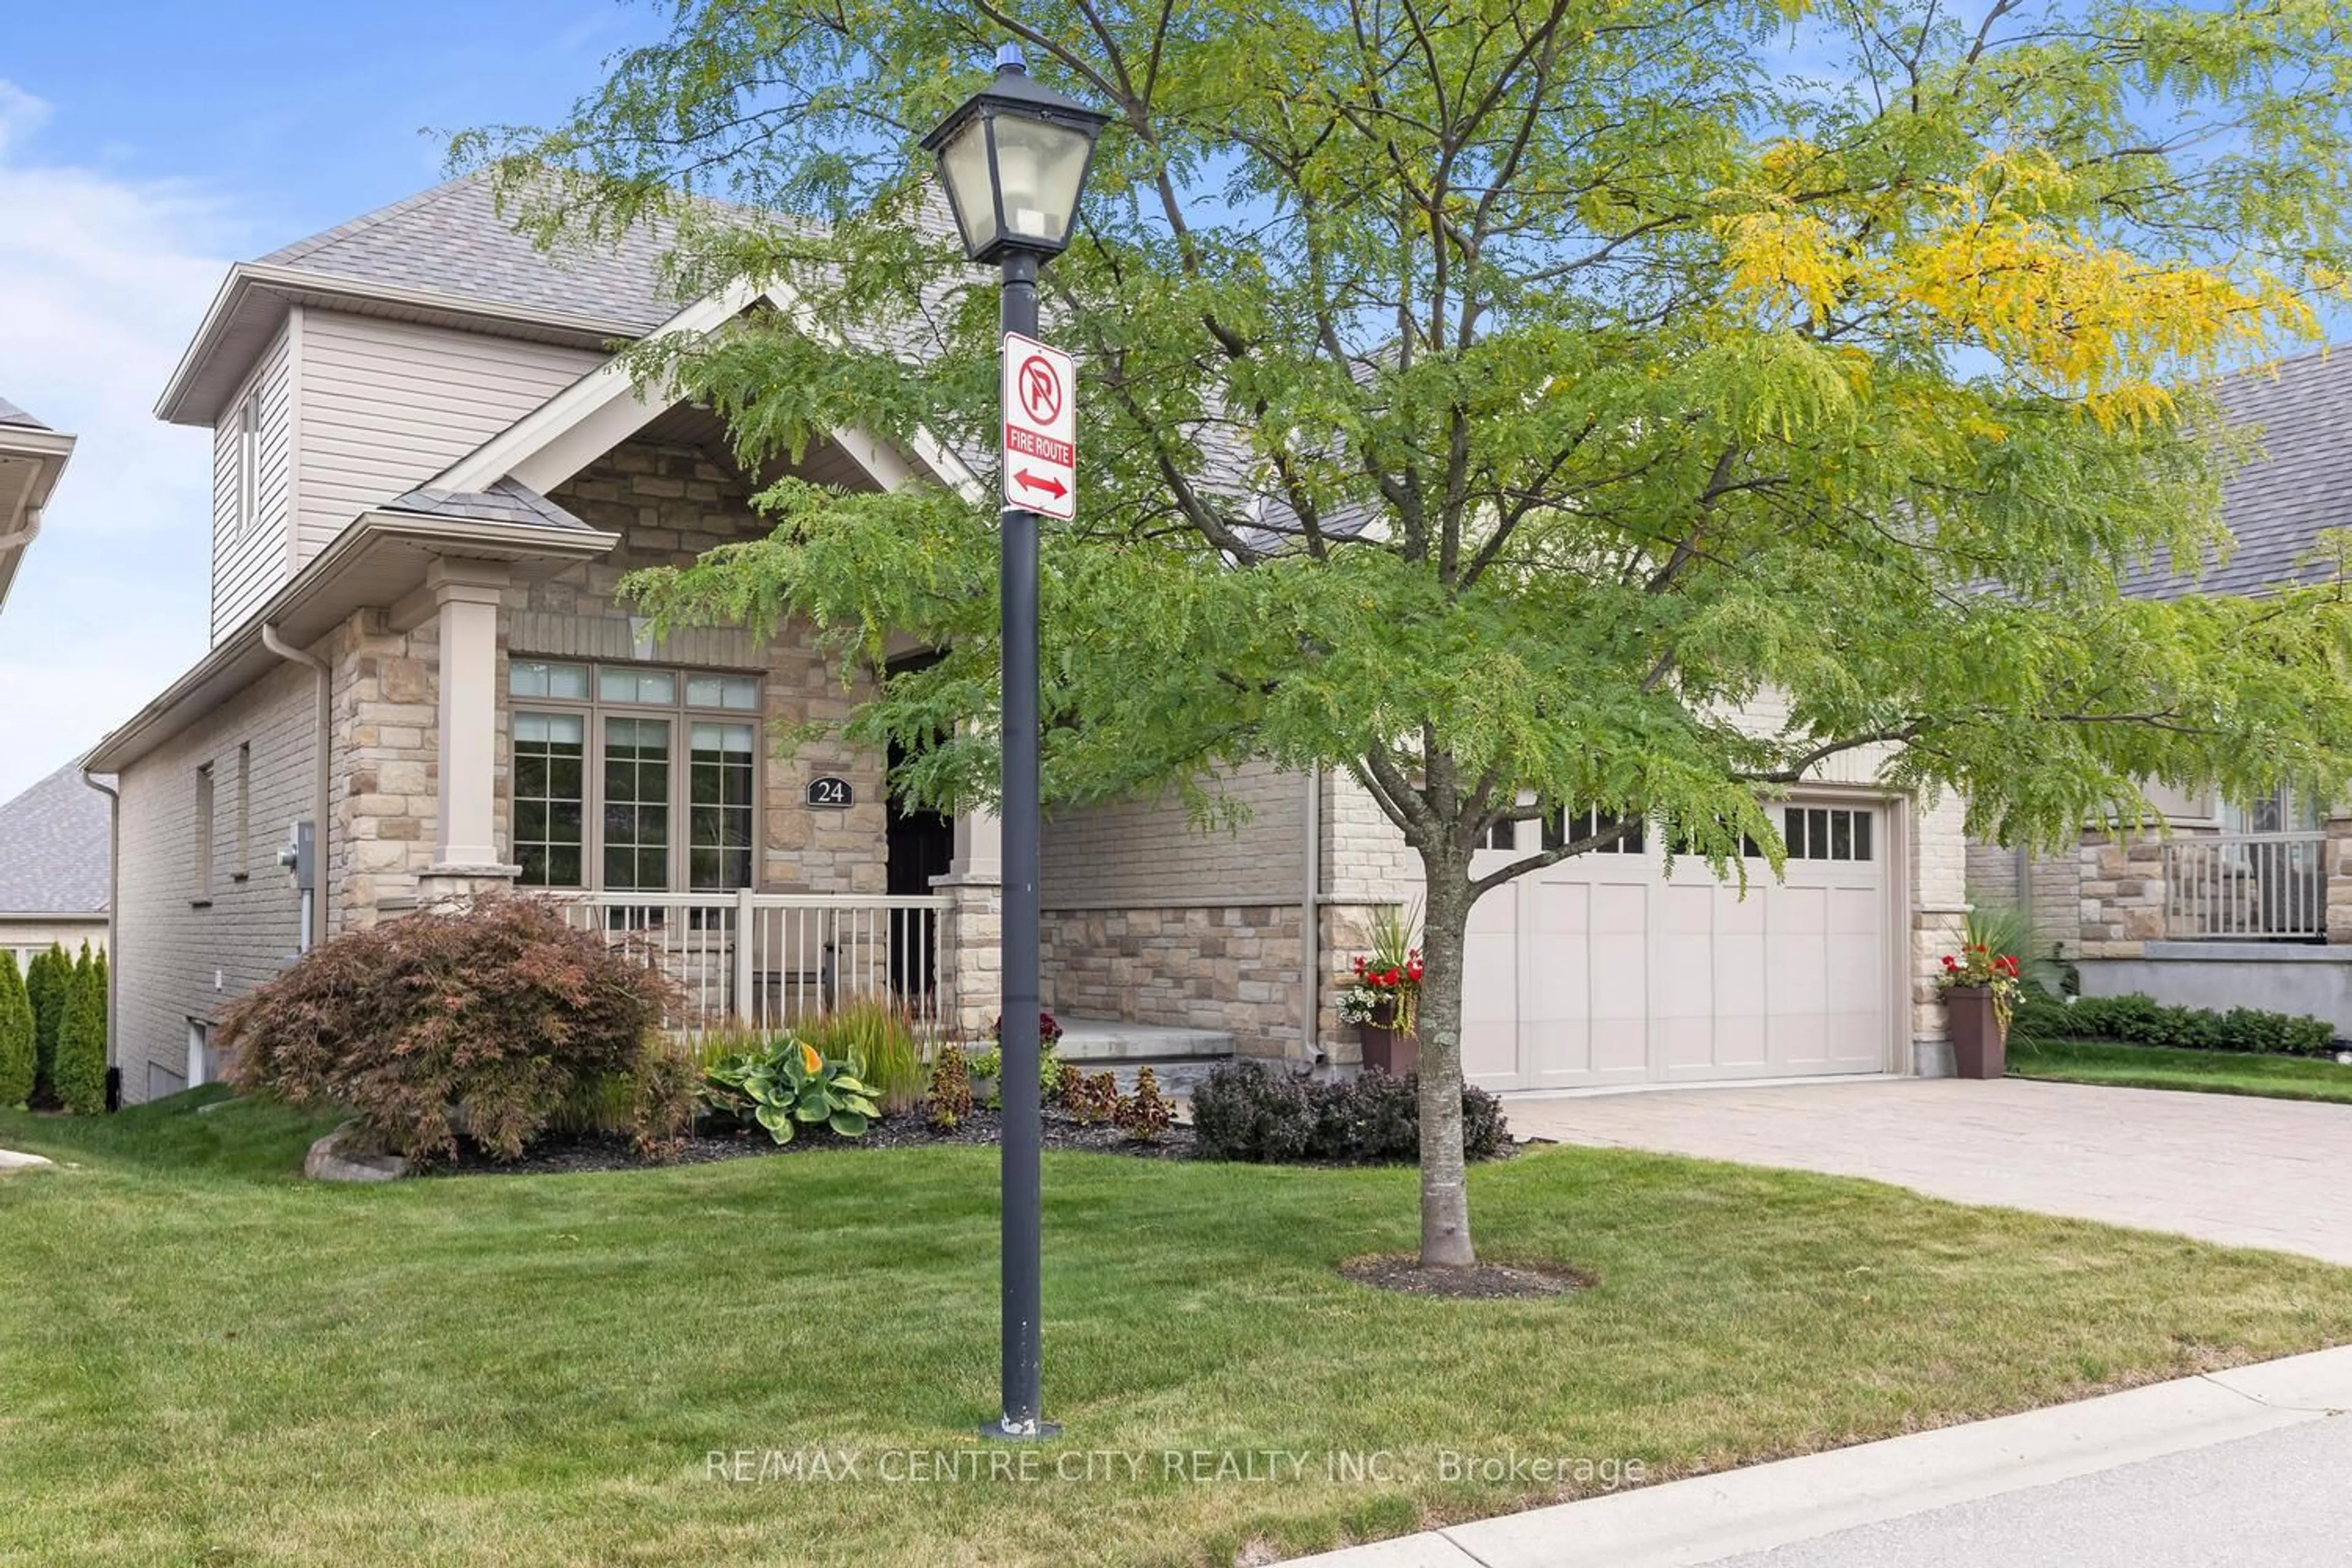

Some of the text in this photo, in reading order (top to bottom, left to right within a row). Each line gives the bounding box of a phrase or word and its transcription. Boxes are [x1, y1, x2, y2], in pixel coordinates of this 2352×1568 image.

[1011, 429, 1069, 463] FIRE ROUTE
[818, 782, 843, 802] 24
